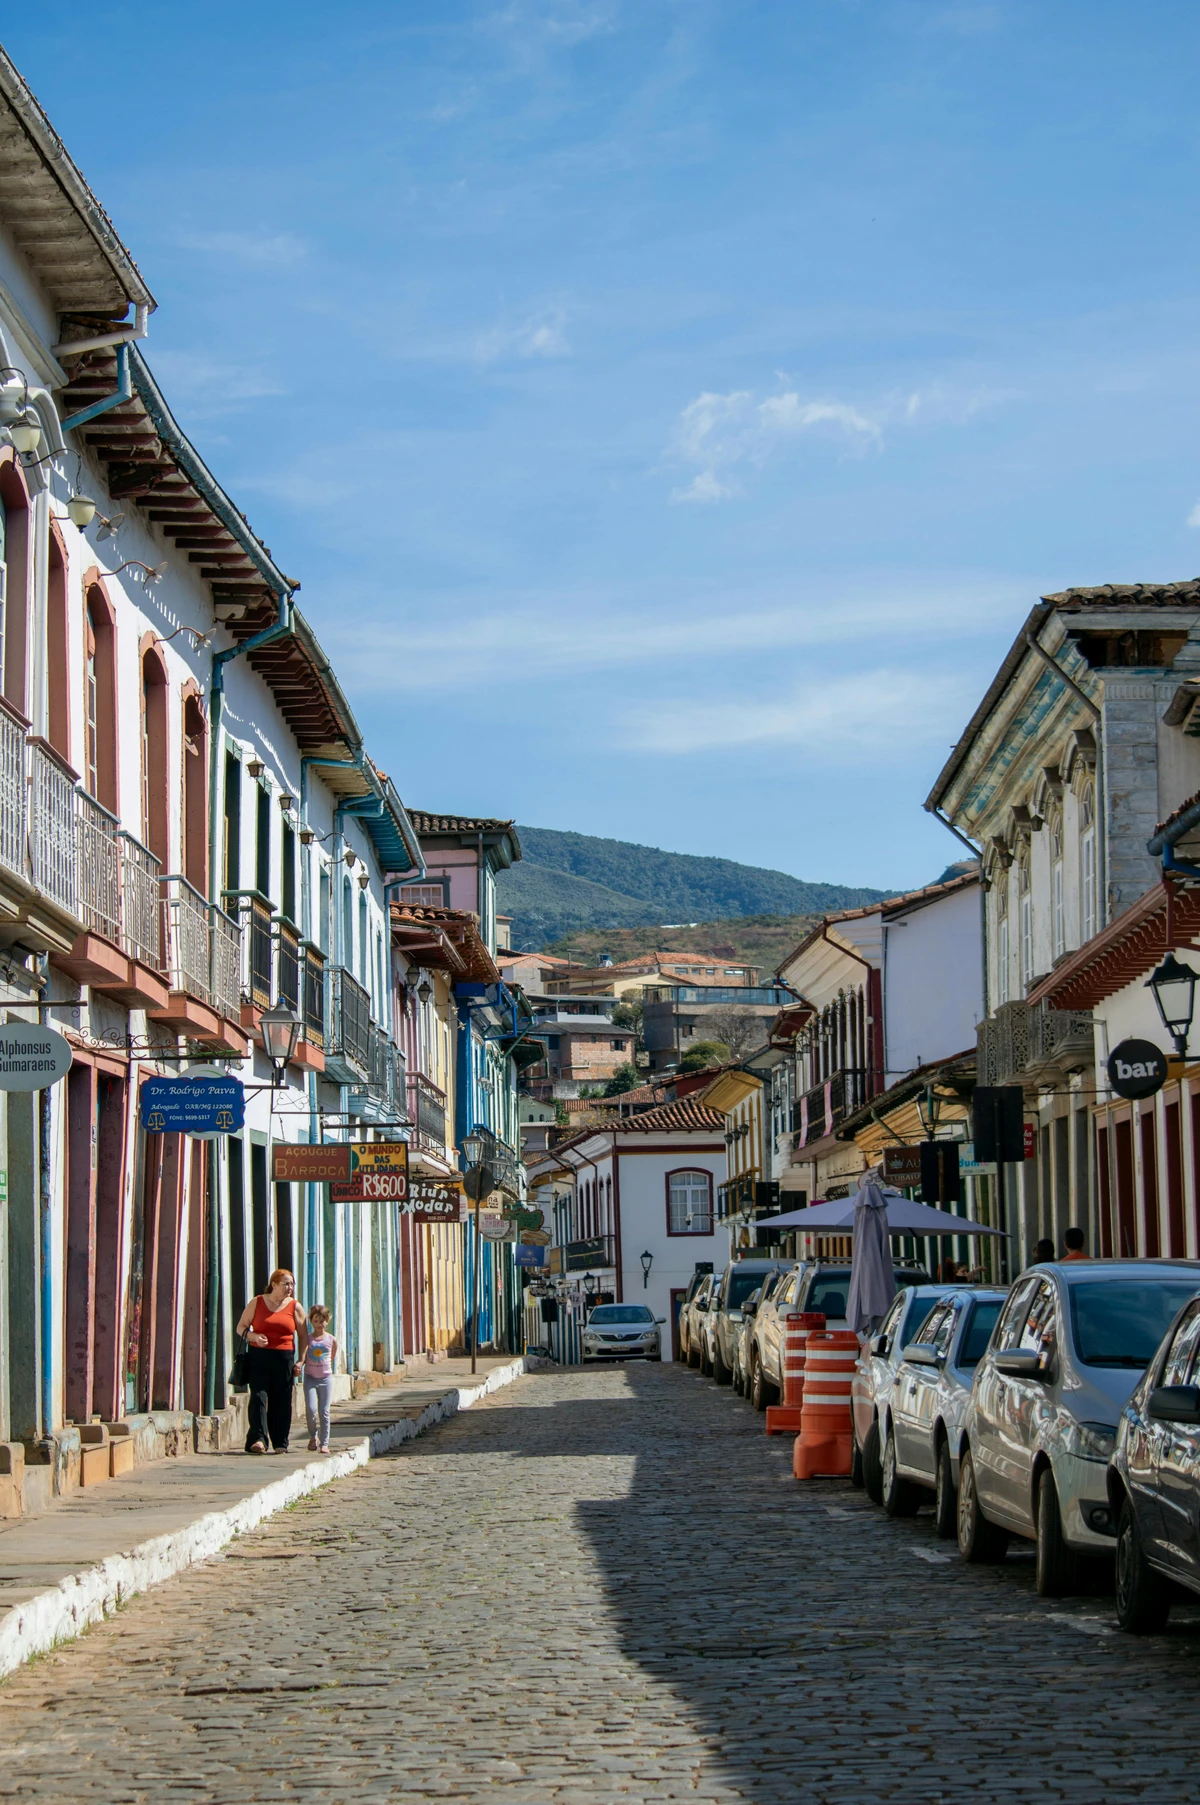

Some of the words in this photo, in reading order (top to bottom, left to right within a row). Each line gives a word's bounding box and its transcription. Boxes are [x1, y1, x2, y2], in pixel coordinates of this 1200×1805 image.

[0, 1040, 51, 1059] Alphonsus
[150, 1086, 166, 1095] Dr.
[169, 1085, 205, 1097] Rodrigo
[208, 1086, 236, 1095] Paiva
[151, 1103, 180, 1111] Advogado
[184, 1103, 211, 1111] OAB/MG
[285, 1147, 337, 1157] AÇOUGUE
[359, 1145, 367, 1155] O
[368, 1145, 401, 1155] MUNDO
[374, 1155, 391, 1164] DAS
[275, 1158, 346, 1177] BARROCA
[359, 1164, 405, 1173] UTILIDADES
